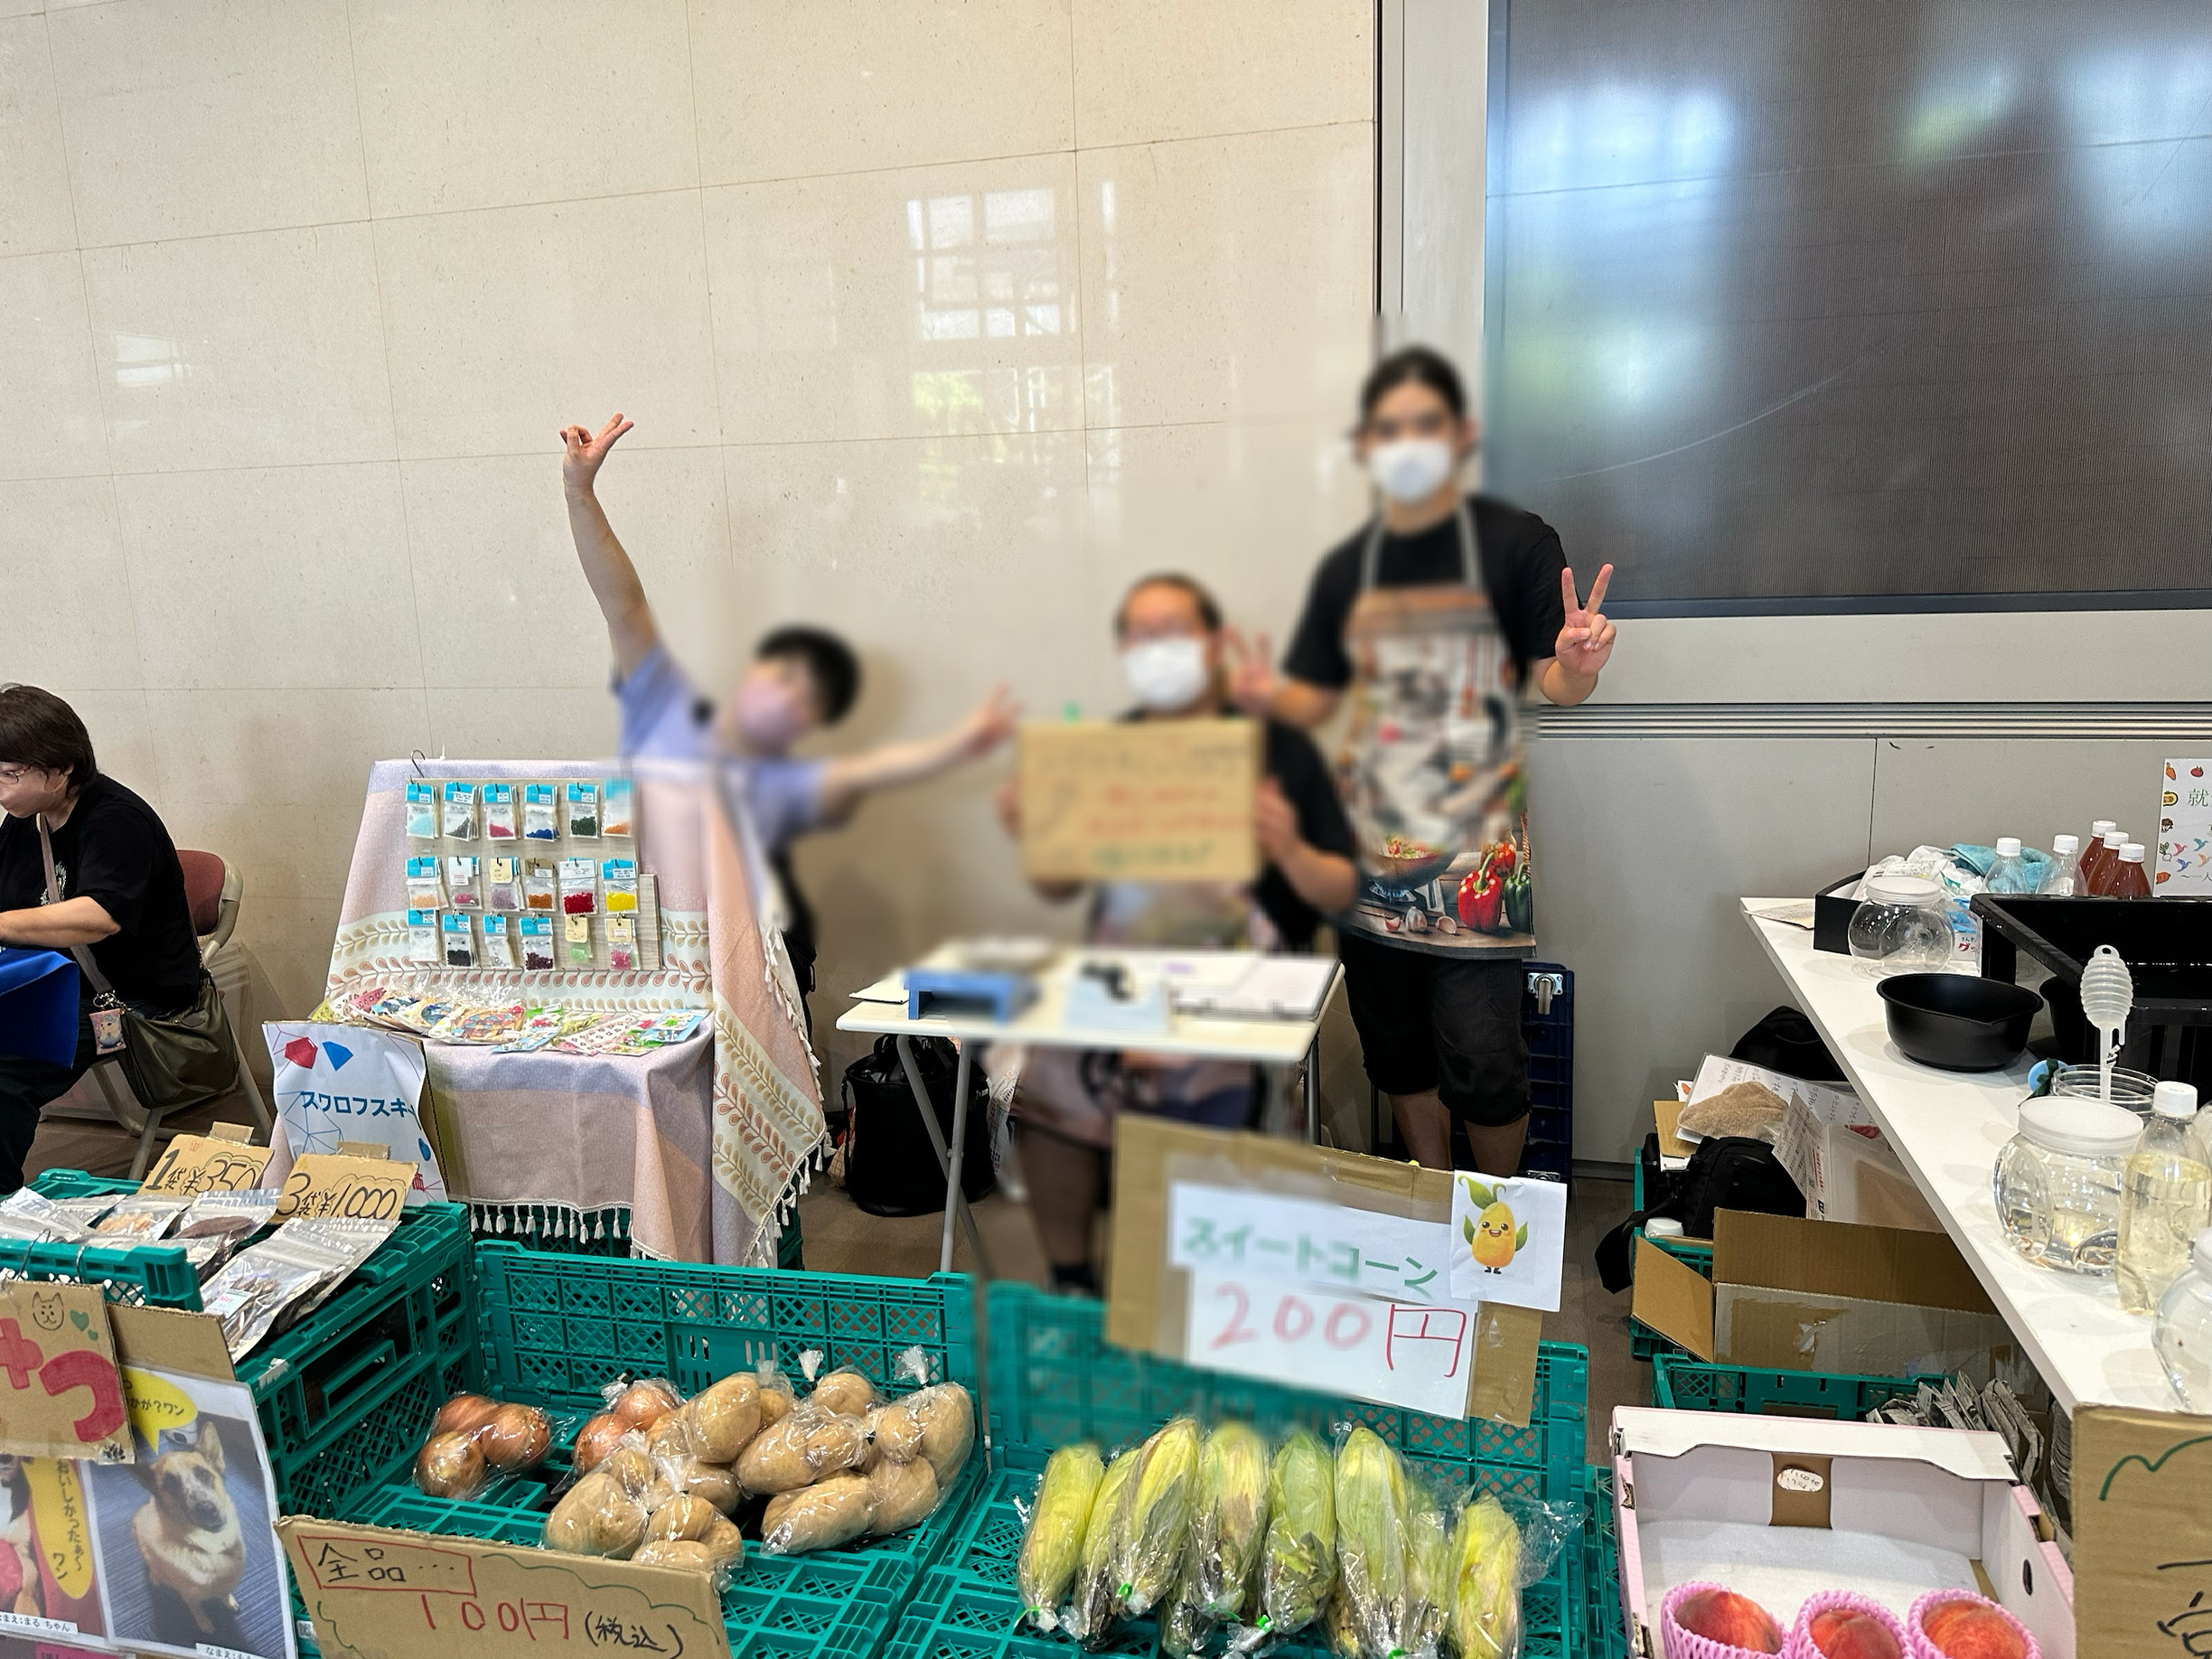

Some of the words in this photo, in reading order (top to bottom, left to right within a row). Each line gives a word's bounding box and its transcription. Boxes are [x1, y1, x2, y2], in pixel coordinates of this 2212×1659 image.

[1182, 1215, 1439, 1289] スイートコーン
[1208, 1280, 1467, 1379] 200円
[52, 1552, 69, 1580] ワン
[45, 1620, 70, 1633] ちゃん
[420, 1593, 569, 1641] 100円
